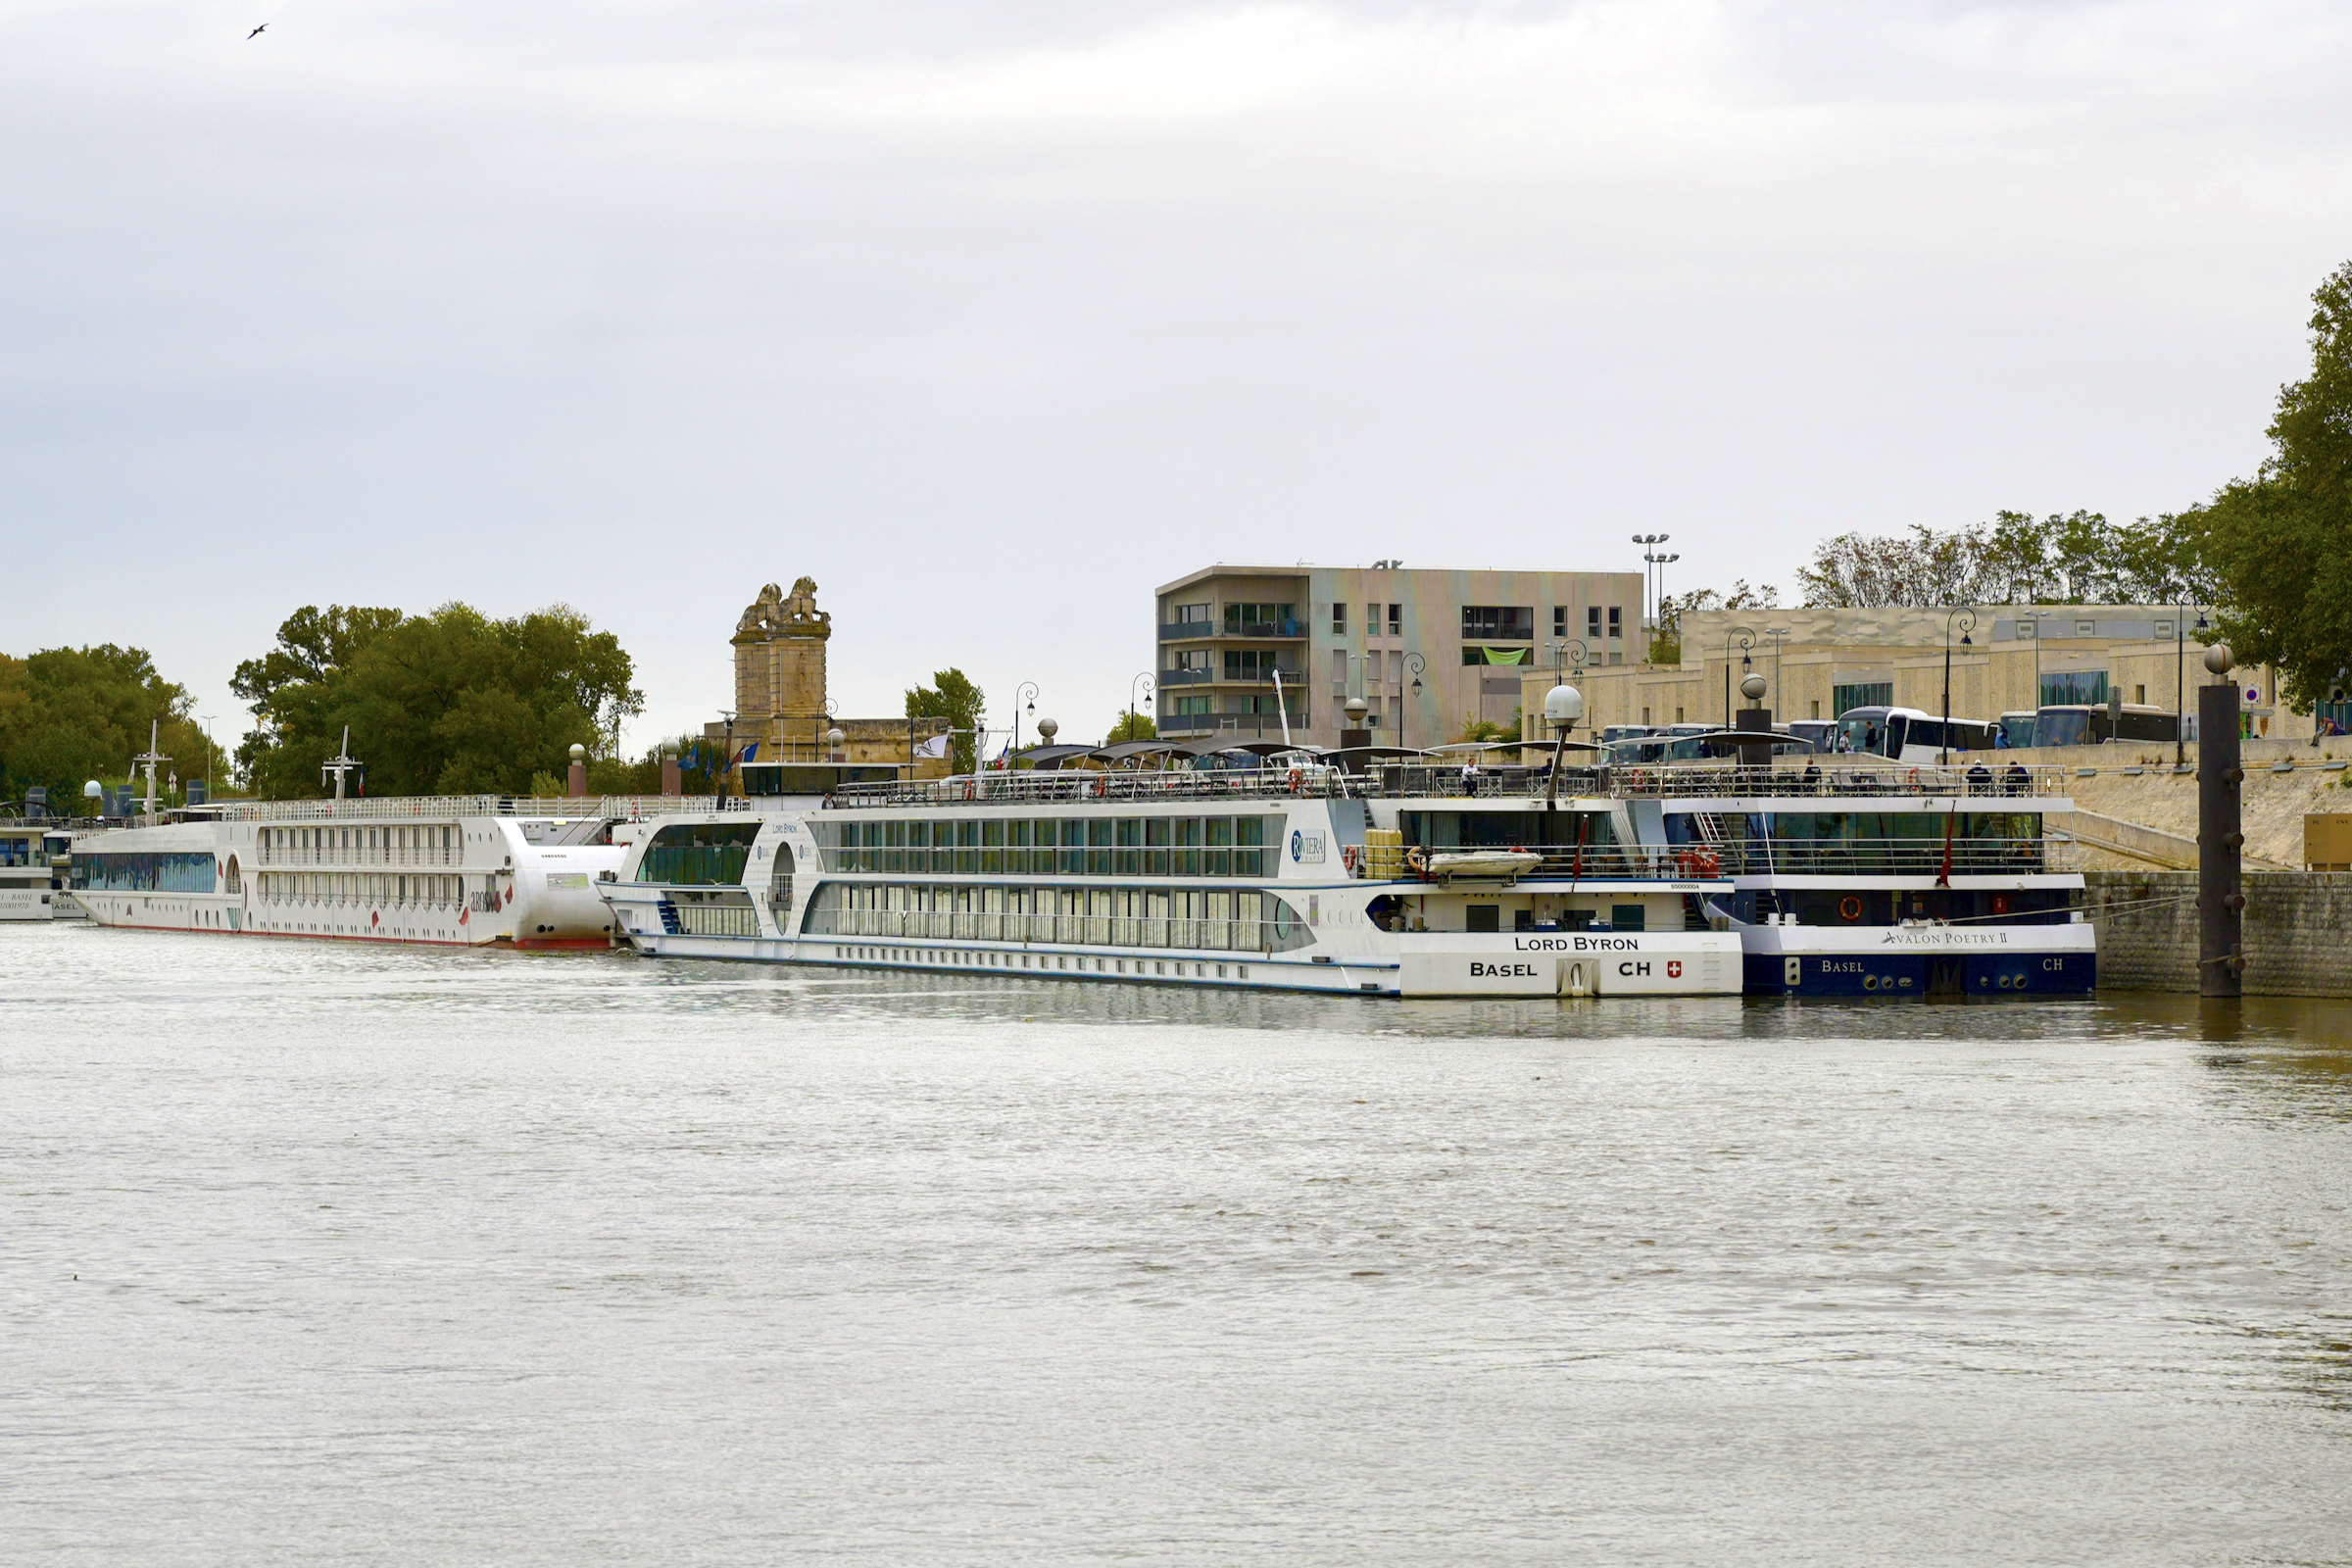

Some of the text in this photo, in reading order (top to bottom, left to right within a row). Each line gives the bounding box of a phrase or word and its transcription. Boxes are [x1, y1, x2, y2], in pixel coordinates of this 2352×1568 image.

[1294, 836, 1323, 857] RIVIERA
[1515, 937, 1639, 951] LORD BYRON
[1882, 931, 2008, 944] AVALON POETRY II
[1470, 962, 1538, 977] BASEL
[1619, 961, 1650, 976] CH
[1822, 960, 1864, 972] BASEL
[2043, 958, 2063, 970] CH
